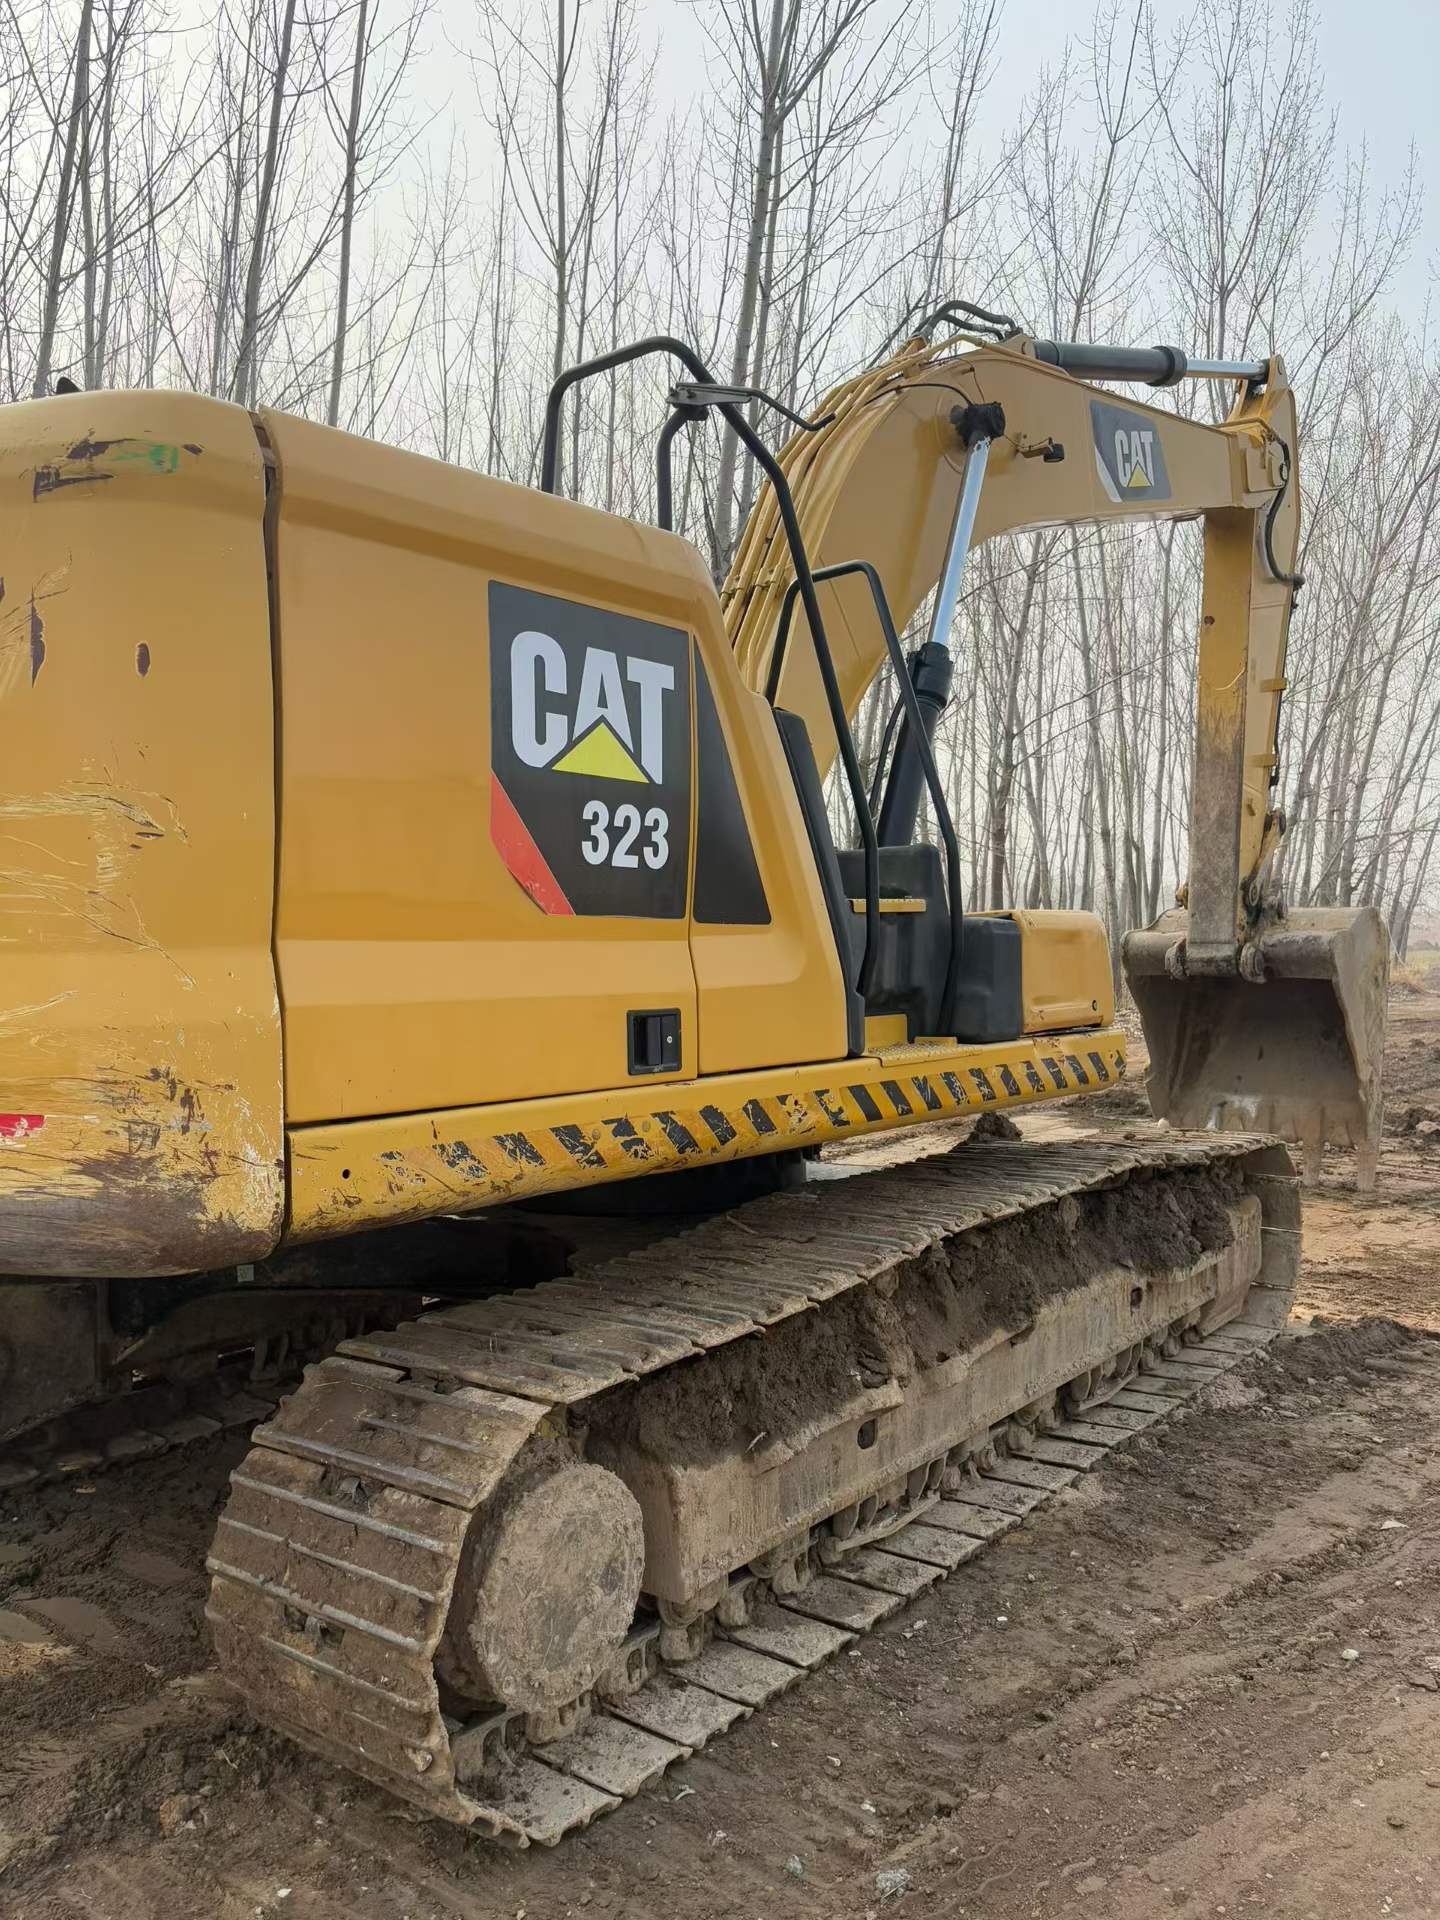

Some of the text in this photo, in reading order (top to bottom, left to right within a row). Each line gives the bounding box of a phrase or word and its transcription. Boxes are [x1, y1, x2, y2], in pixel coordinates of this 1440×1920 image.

[1115, 430, 1154, 487] CAT
[511, 631, 674, 784] CAT
[582, 800, 669, 869] 323
